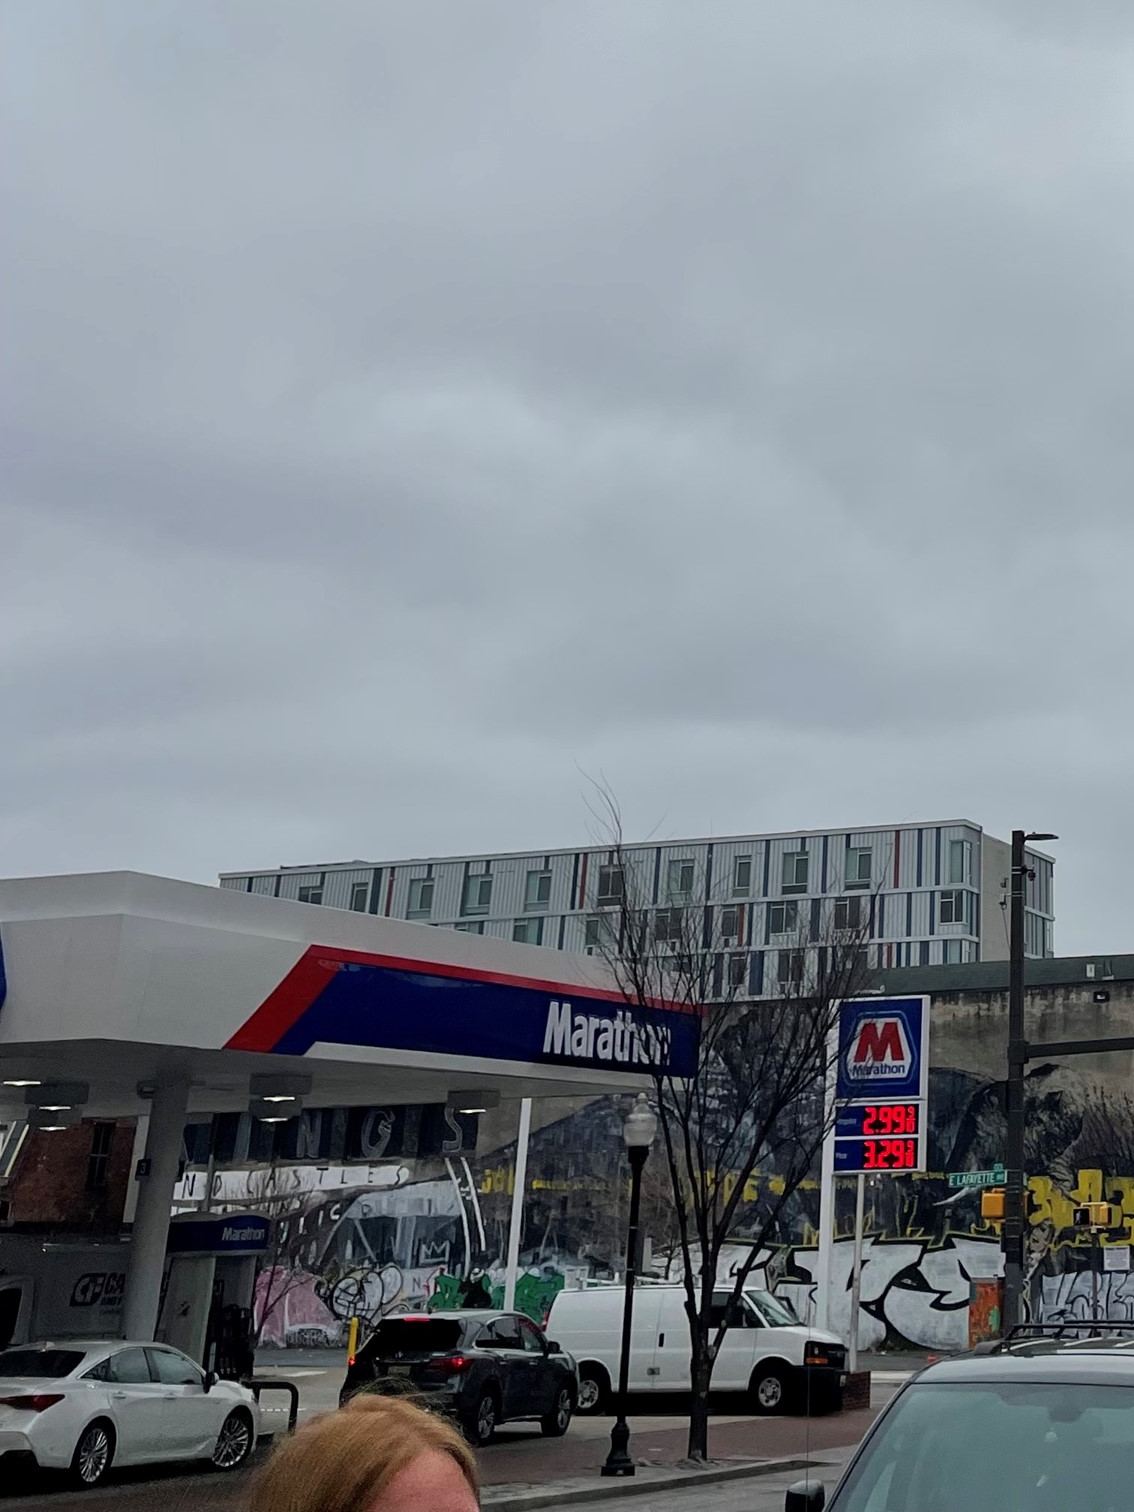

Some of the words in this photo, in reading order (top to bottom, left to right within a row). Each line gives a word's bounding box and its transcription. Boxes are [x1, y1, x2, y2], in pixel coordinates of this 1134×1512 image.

[543, 1001, 671, 1067] Marathon
[863, 1106, 906, 1135] 2.99
[863, 1140, 906, 1168] 3.29
[140, 1162, 147, 1175] 3
[948, 1176, 955, 1186] E
[956, 1172, 995, 1186] LAFAYETTE
[221, 1227, 266, 1242] Marathon
